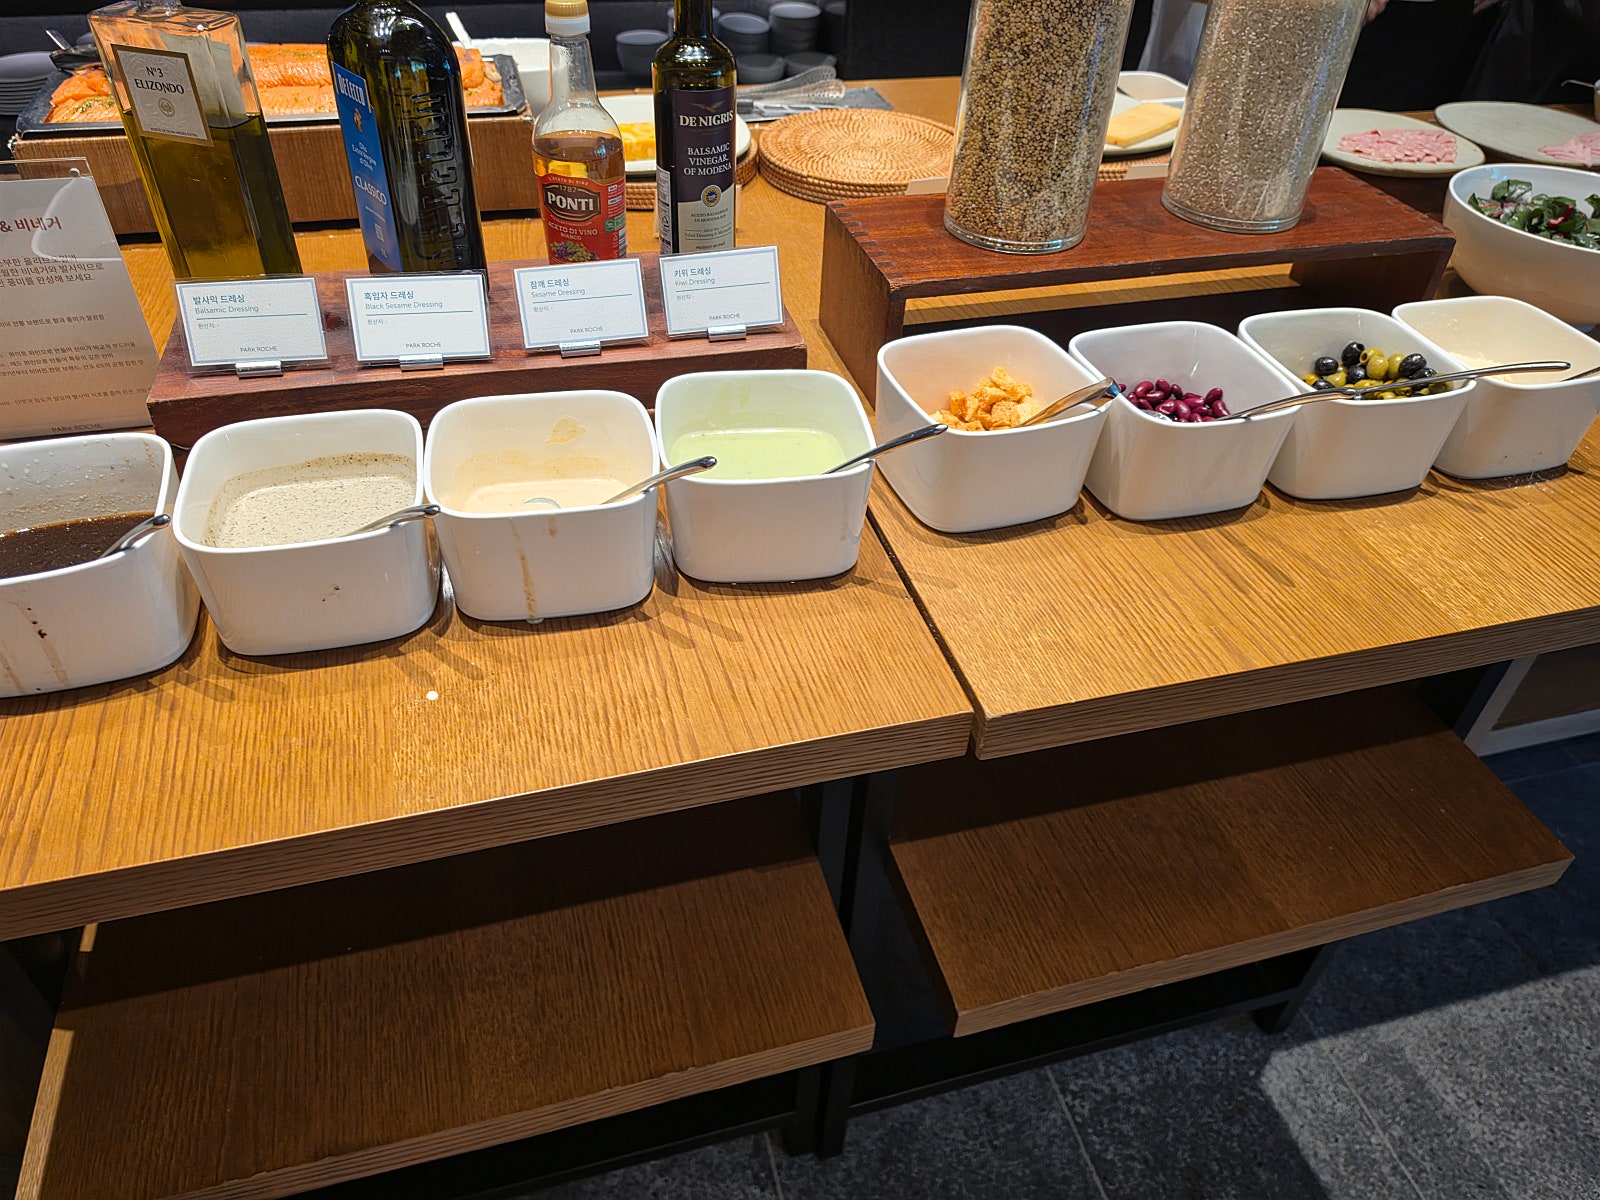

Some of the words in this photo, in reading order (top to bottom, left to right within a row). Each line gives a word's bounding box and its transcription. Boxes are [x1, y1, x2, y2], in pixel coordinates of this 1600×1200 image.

[134, 78, 184, 94] ELIZONDO
[680, 115, 696, 127] DE
[699, 110, 734, 127] NIGRIS
[688, 142, 730, 155] BALSAMIC
[689, 154, 729, 166] VINEGAR
[684, 167, 696, 176] OF
[698, 162, 732, 176] MODENA
[355, 175, 387, 206] CLASSICO
[547, 191, 594, 211] PONTI
[0, 221, 12, 232] &
[15, 216, 62, 231] 비네거
[560, 232, 582, 240] BIANCO
[21, 266, 58, 276] 비네거와
[59, 262, 104, 273] 발사믹으로
[674, 269, 688, 278] 키위
[690, 267, 711, 276] 드레싱
[530, 280, 546, 289] 참깨
[547, 278, 570, 287] 드레싱
[193, 295, 218, 305] 발사믹
[220, 294, 245, 303] 드레싱
[364, 292, 388, 301] 흑임자
[390, 290, 414, 299] 드레싱
[195, 306, 227, 314] Balsamic
[228, 304, 259, 313] Dressing
[413, 301, 443, 309] Dressing
